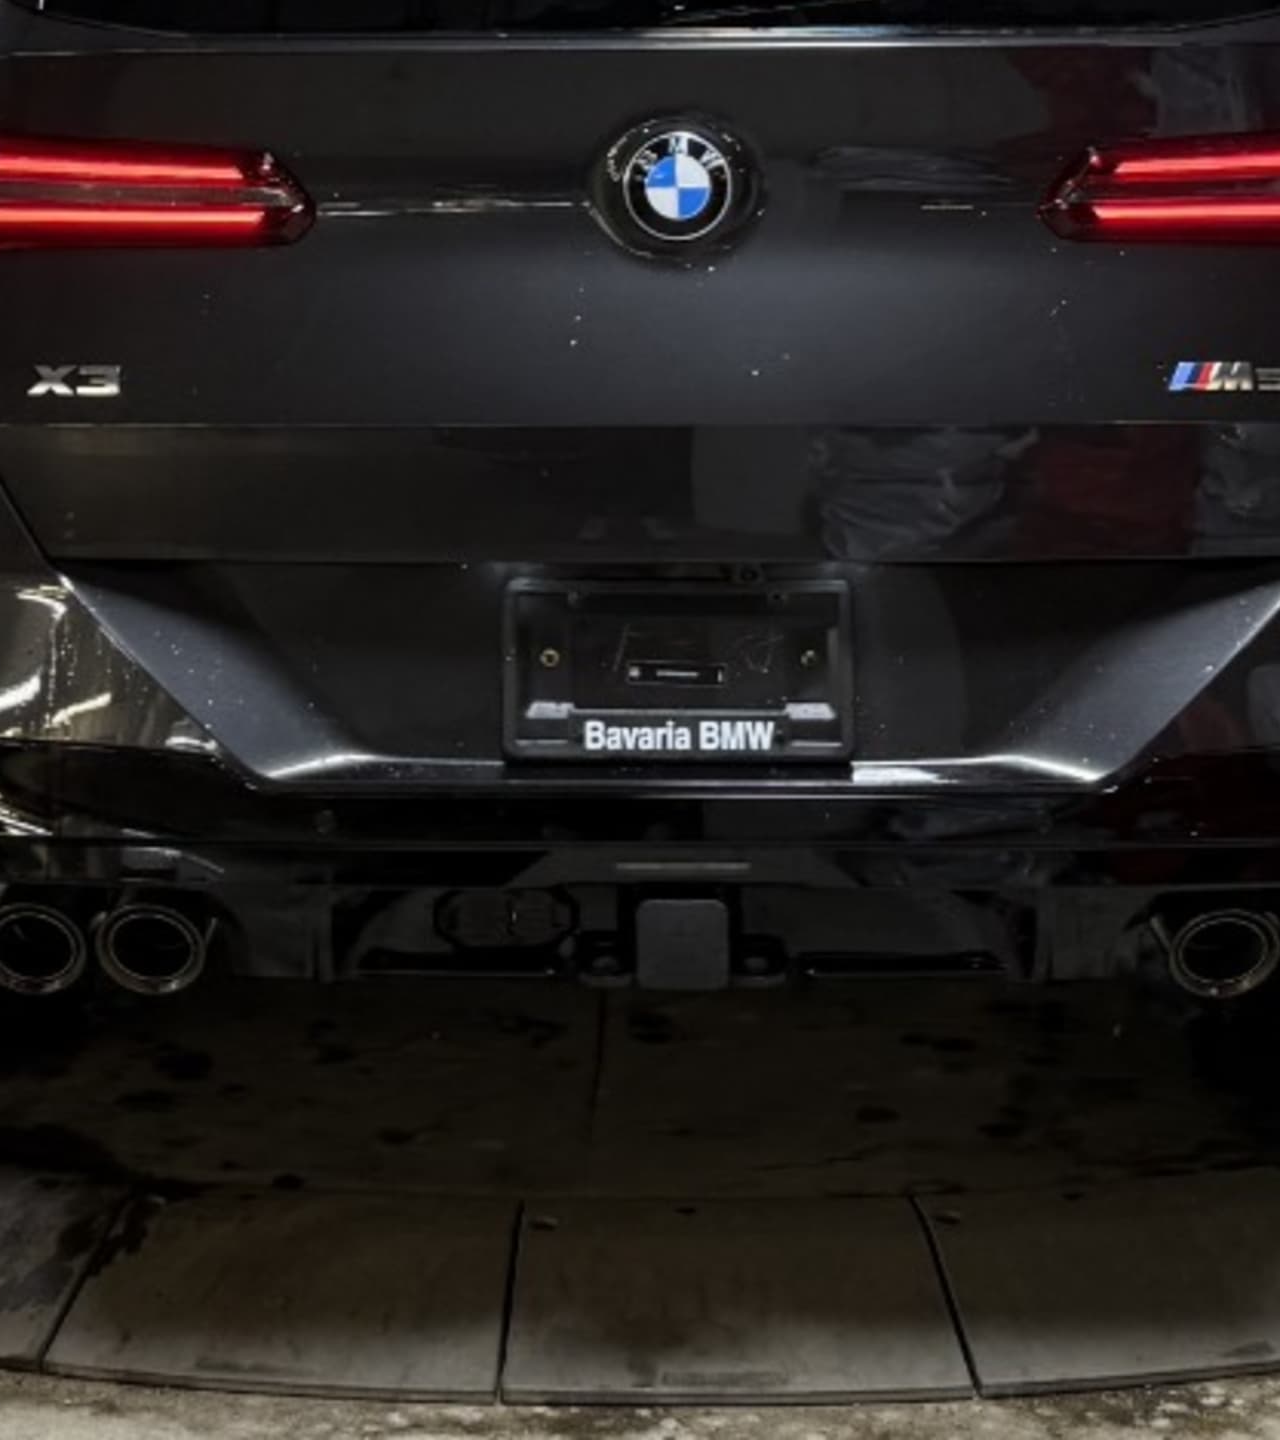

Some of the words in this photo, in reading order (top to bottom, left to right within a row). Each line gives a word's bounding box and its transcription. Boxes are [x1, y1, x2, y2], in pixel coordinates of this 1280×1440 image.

[637, 136, 724, 171] BMW
[27, 365, 121, 397] X3
[584, 719, 692, 751] Bavaria
[699, 720, 775, 751] BMW
